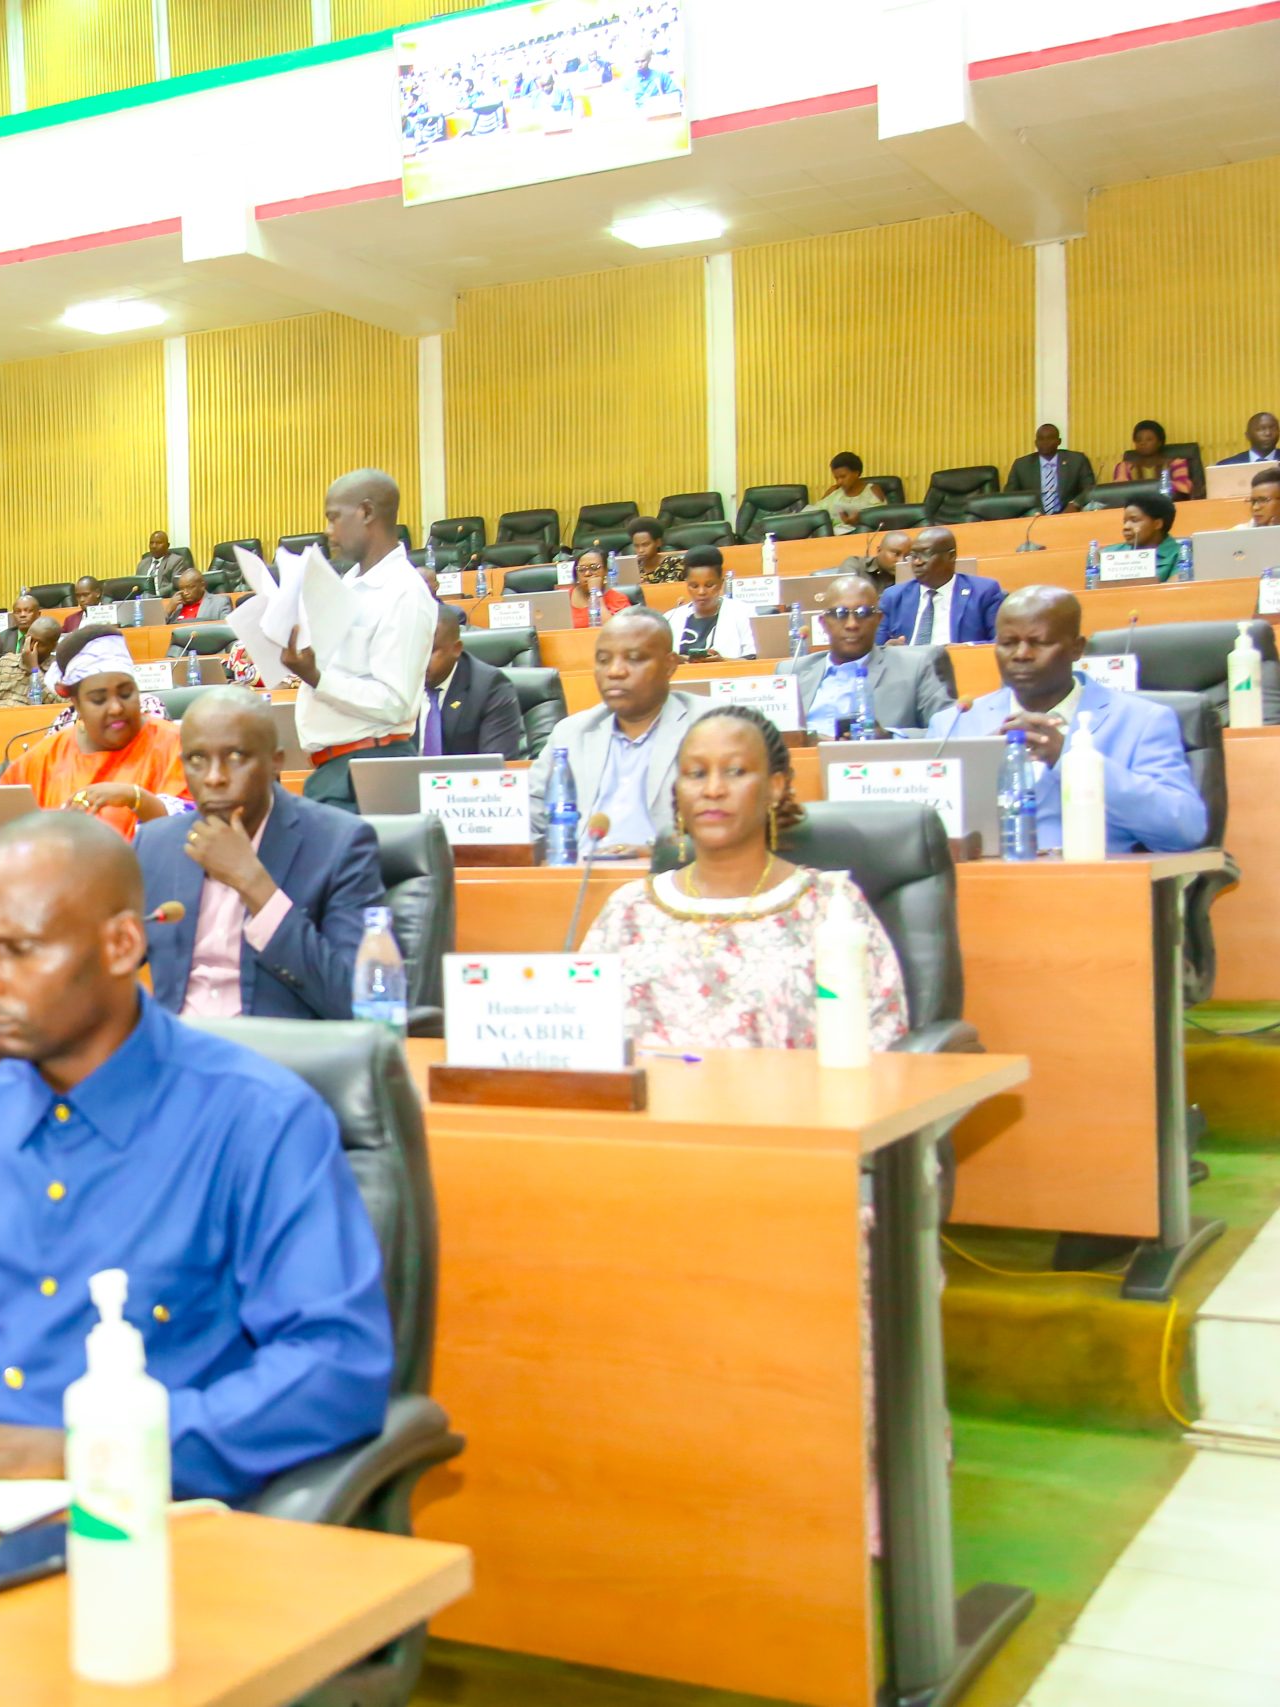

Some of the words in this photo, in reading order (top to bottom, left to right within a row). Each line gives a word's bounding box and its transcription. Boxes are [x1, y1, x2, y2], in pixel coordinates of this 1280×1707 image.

[861, 784, 930, 795] Honorable
[447, 794, 502, 803] Honorable
[429, 806, 524, 819] MANIRAKIZA
[487, 1001, 577, 1016] Honorable
[475, 1023, 587, 1041] INGABIRE
